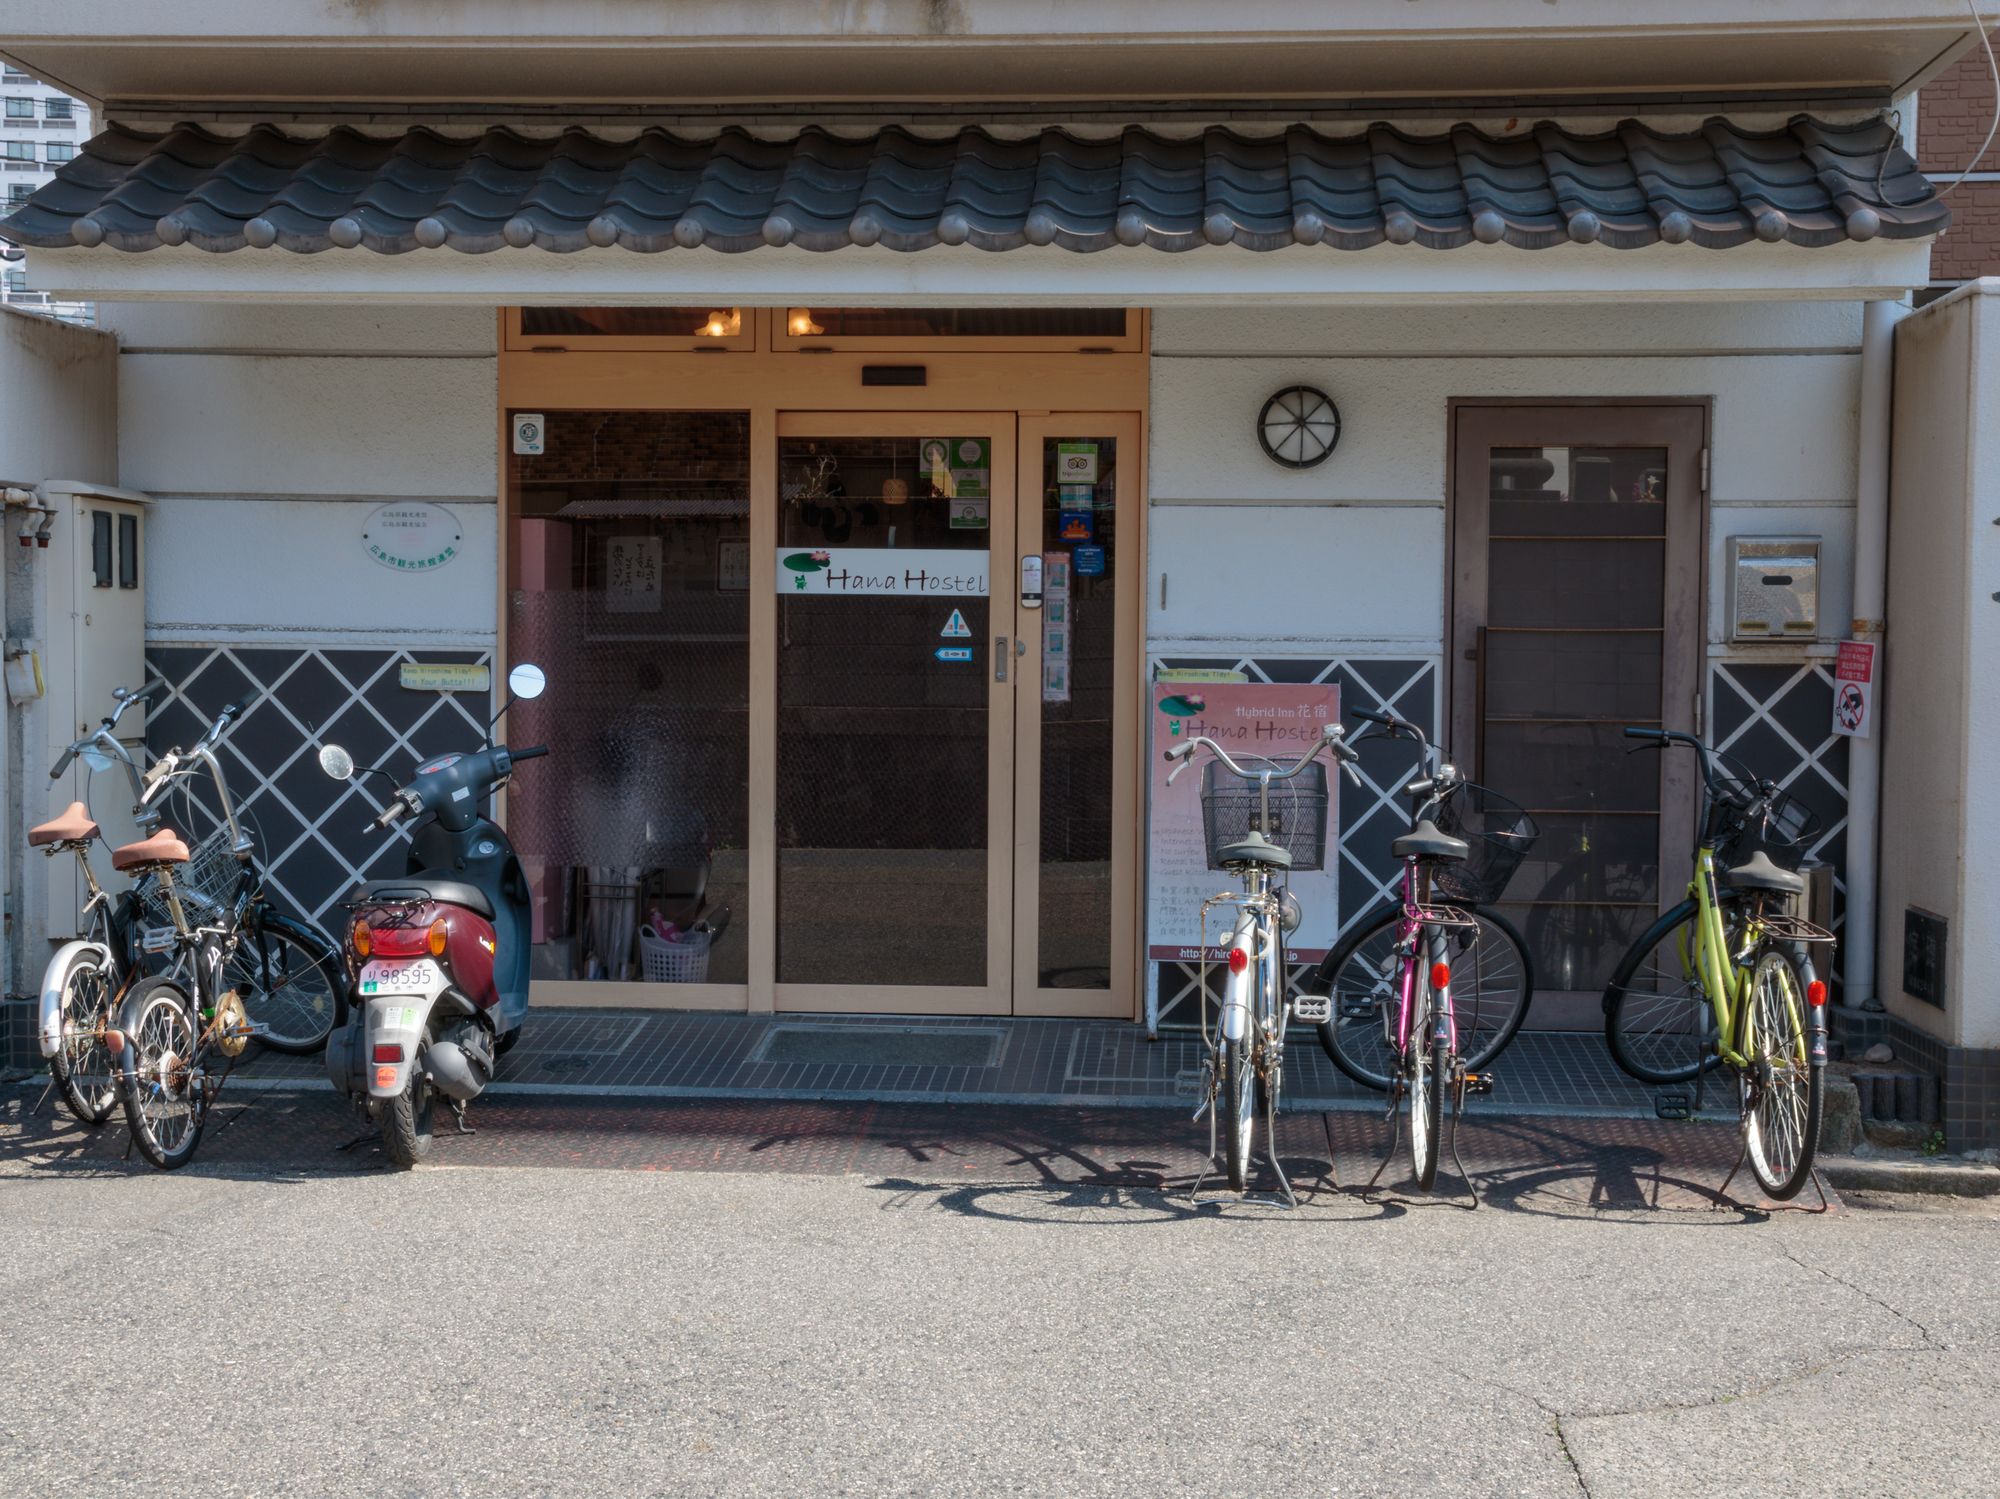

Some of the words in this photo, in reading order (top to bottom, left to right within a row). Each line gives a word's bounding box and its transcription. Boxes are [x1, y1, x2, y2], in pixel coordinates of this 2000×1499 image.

[826, 568, 896, 590] Hana
[905, 569, 987, 593] Hostel
[1235, 706, 1275, 720] Hybrid
[1278, 708, 1295, 717] Inn
[1186, 720, 1248, 739] Hana
[380, 969, 431, 985] 98595
